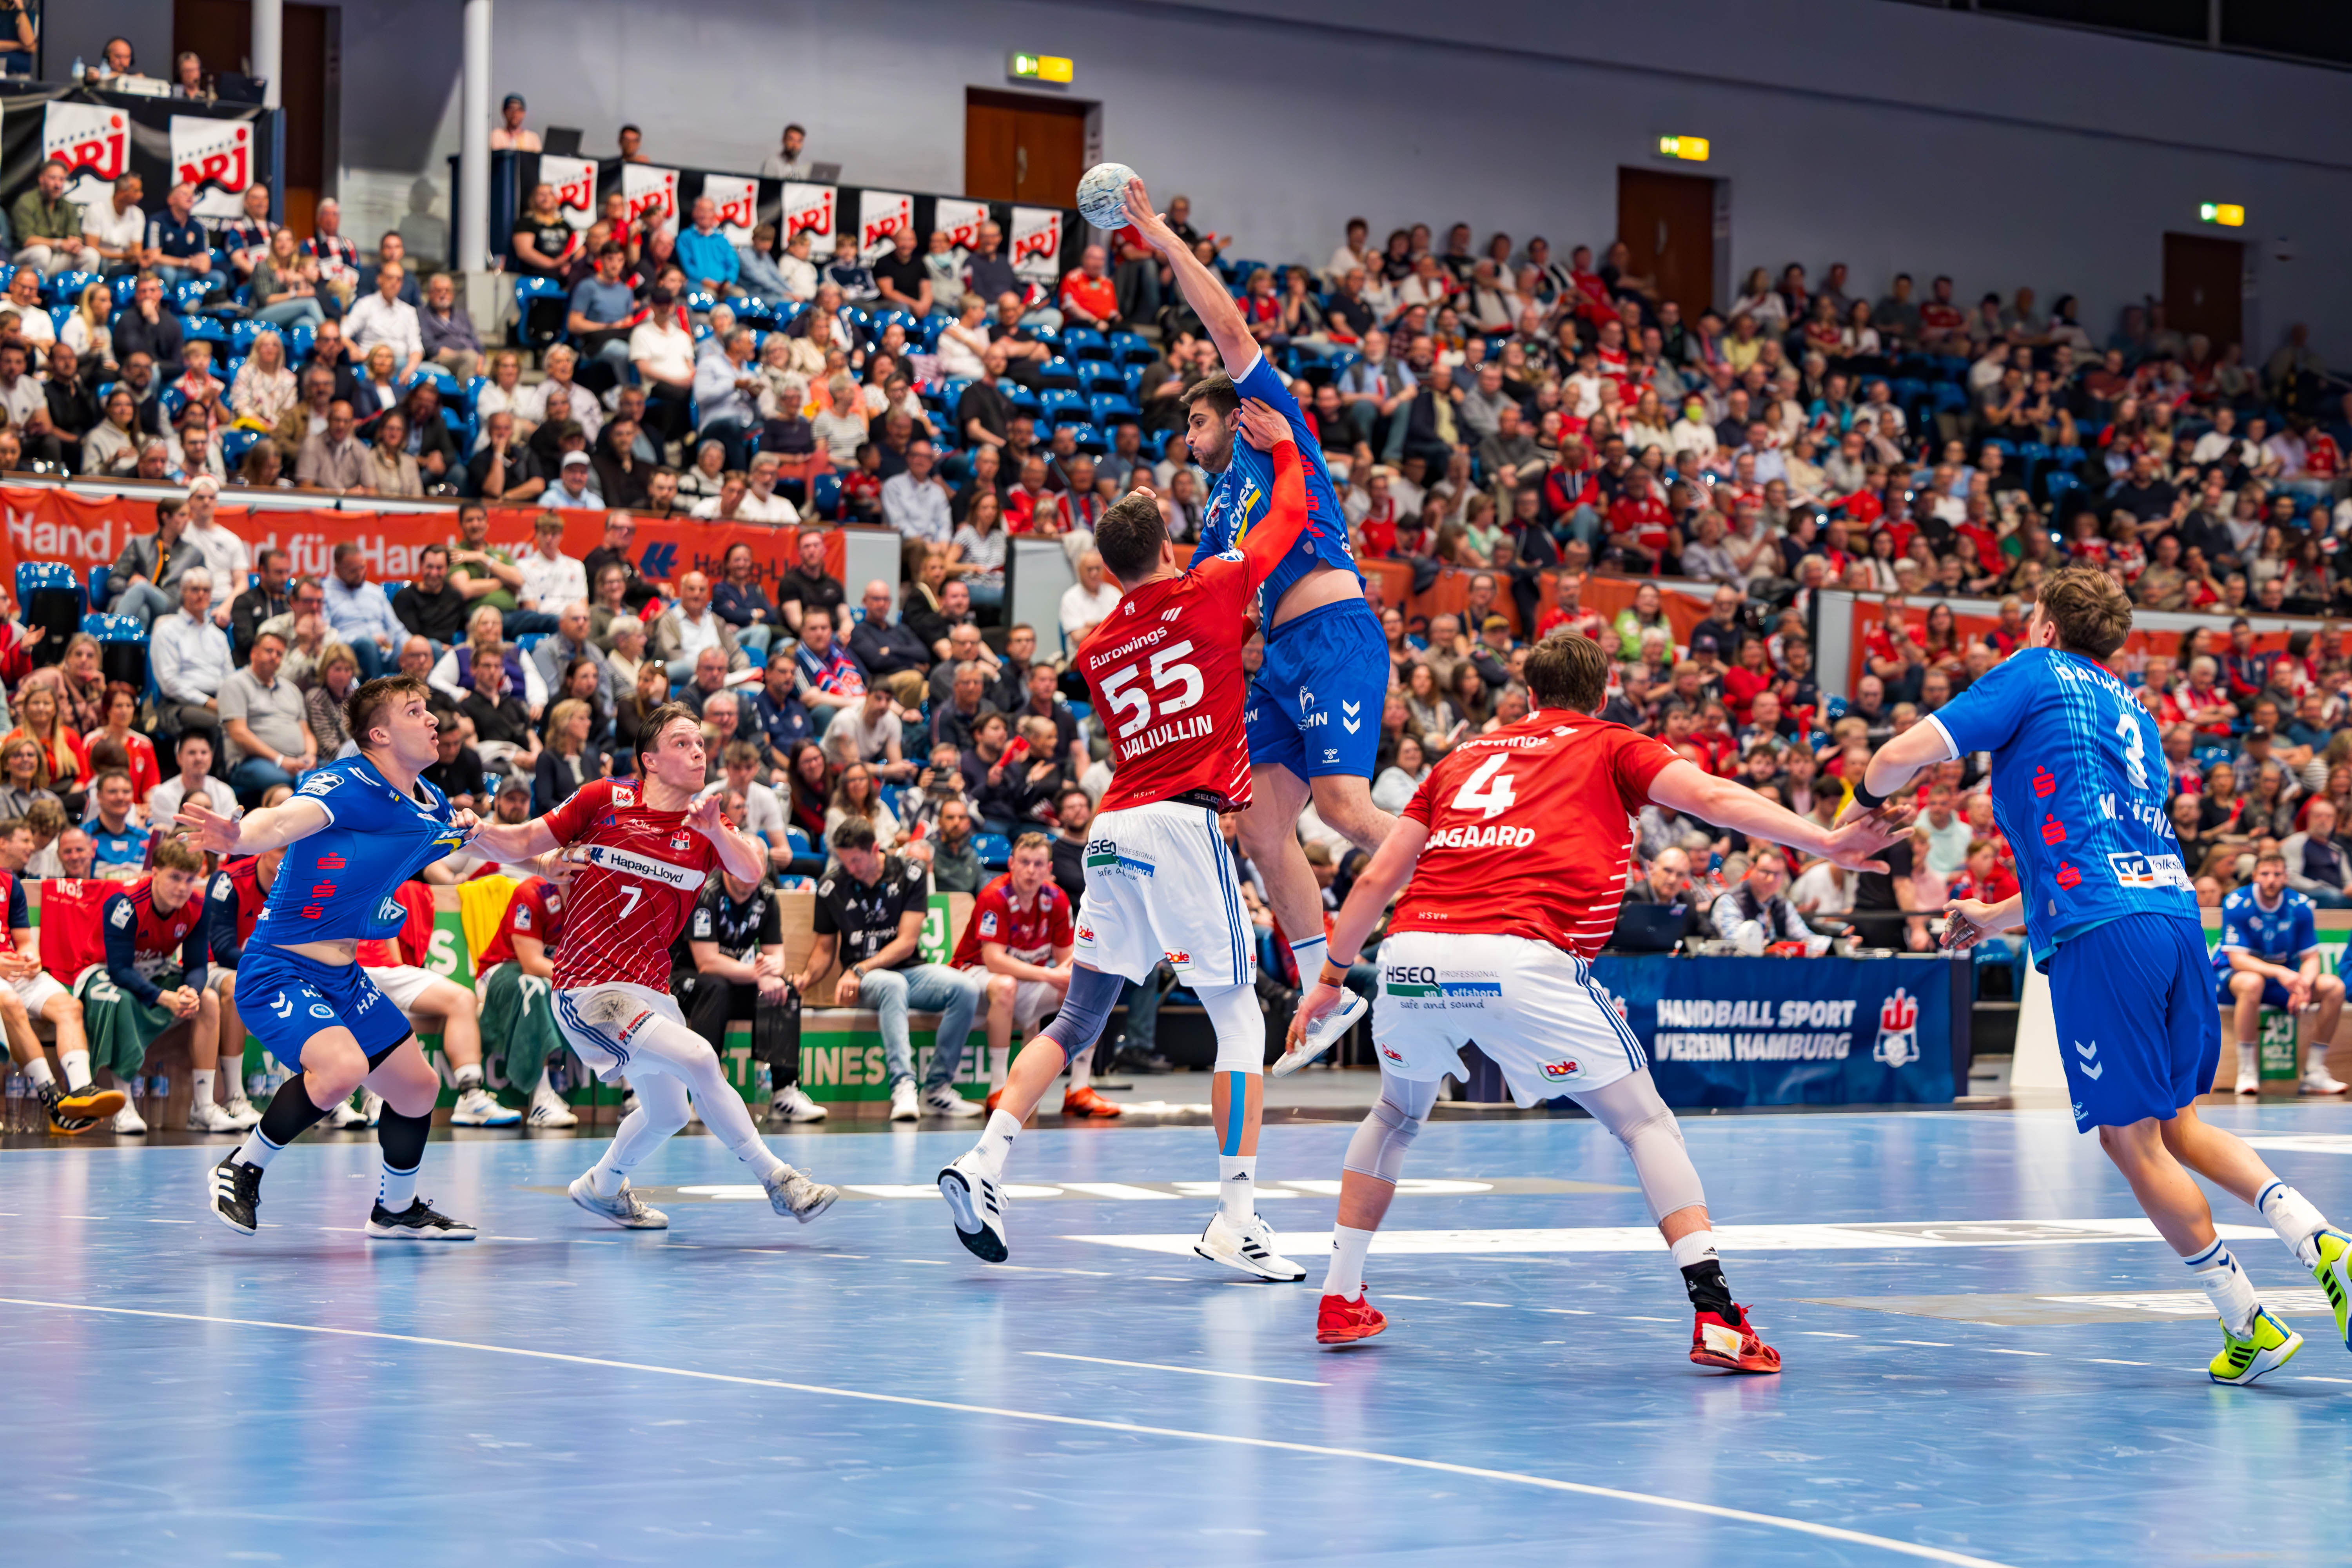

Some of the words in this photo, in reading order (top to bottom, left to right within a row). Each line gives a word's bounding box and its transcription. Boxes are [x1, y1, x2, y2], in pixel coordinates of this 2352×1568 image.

[558, 167, 592, 211] RJ
[716, 185, 753, 229] RJ
[6, 508, 112, 561] Hand
[1089, 626, 1167, 670] Eurowings
[1100, 640, 1204, 738] 55
[1120, 715, 1213, 760] VALIULLIN
[1194, 793, 1220, 804] SELEC
[1451, 752, 1516, 819] 4
[611, 852, 684, 884] Hapag-Lloyd
[619, 885, 642, 919] 7
[1165, 951, 1189, 963] Dole
[1386, 965, 1441, 988] HSEQ
[1440, 970, 1501, 978] PROFESSIONAL
[1452, 987, 1499, 997] offshore
[1400, 998, 1419, 1009] safe
[1423, 999, 1446, 1009] and
[1450, 999, 1485, 1009] sound
[1656, 999, 1775, 1027] HANDBALL
[1778, 1000, 1857, 1028] SPORT
[1654, 1033, 1732, 1061] VEREIN
[1734, 1032, 1853, 1060] HAMBURG
[1545, 1060, 1577, 1076] Dole
